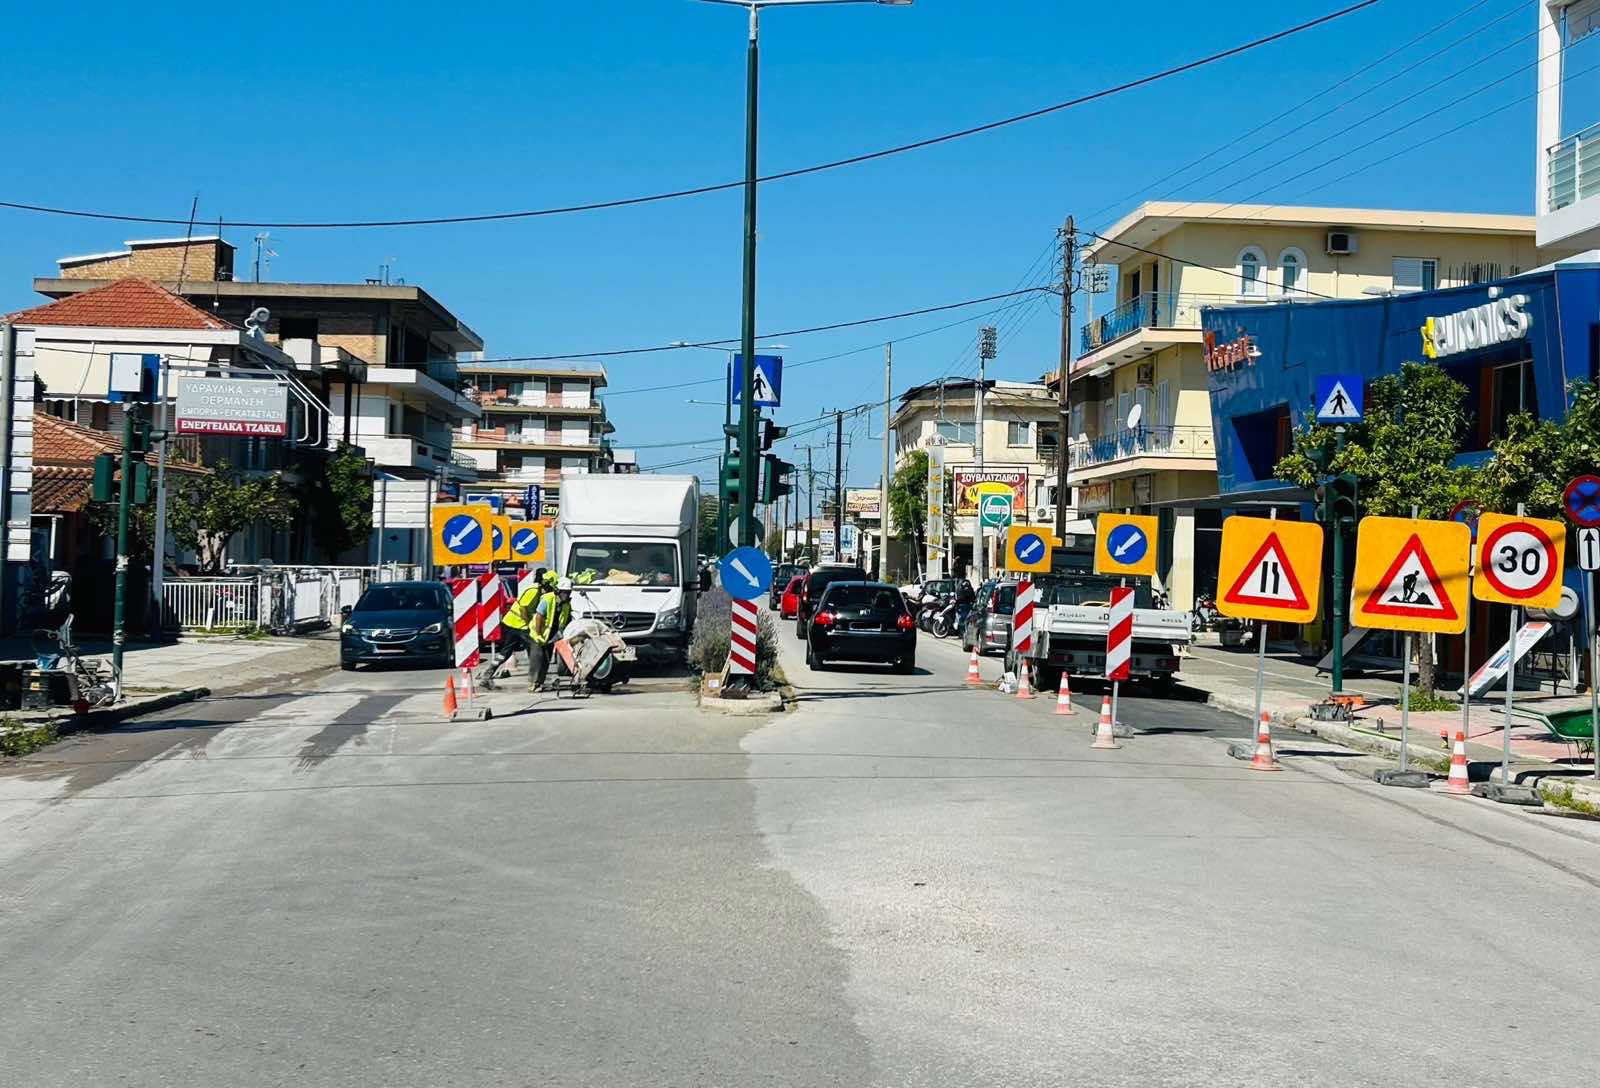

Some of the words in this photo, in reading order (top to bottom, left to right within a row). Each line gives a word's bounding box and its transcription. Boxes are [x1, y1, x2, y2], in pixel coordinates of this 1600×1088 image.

[1434, 286, 1532, 358] euronics
[186, 383, 243, 395] ΥΔΡΑΥΛΙΚΑ
[200, 395, 264, 406] ΘΕΡΜΑΝΣΗ
[181, 420, 243, 431] ΕΝΕΡΓΕΙΑΚΑ
[244, 423, 281, 433] ΤΖΑΚΙΑ
[1498, 545, 1541, 576] 30
